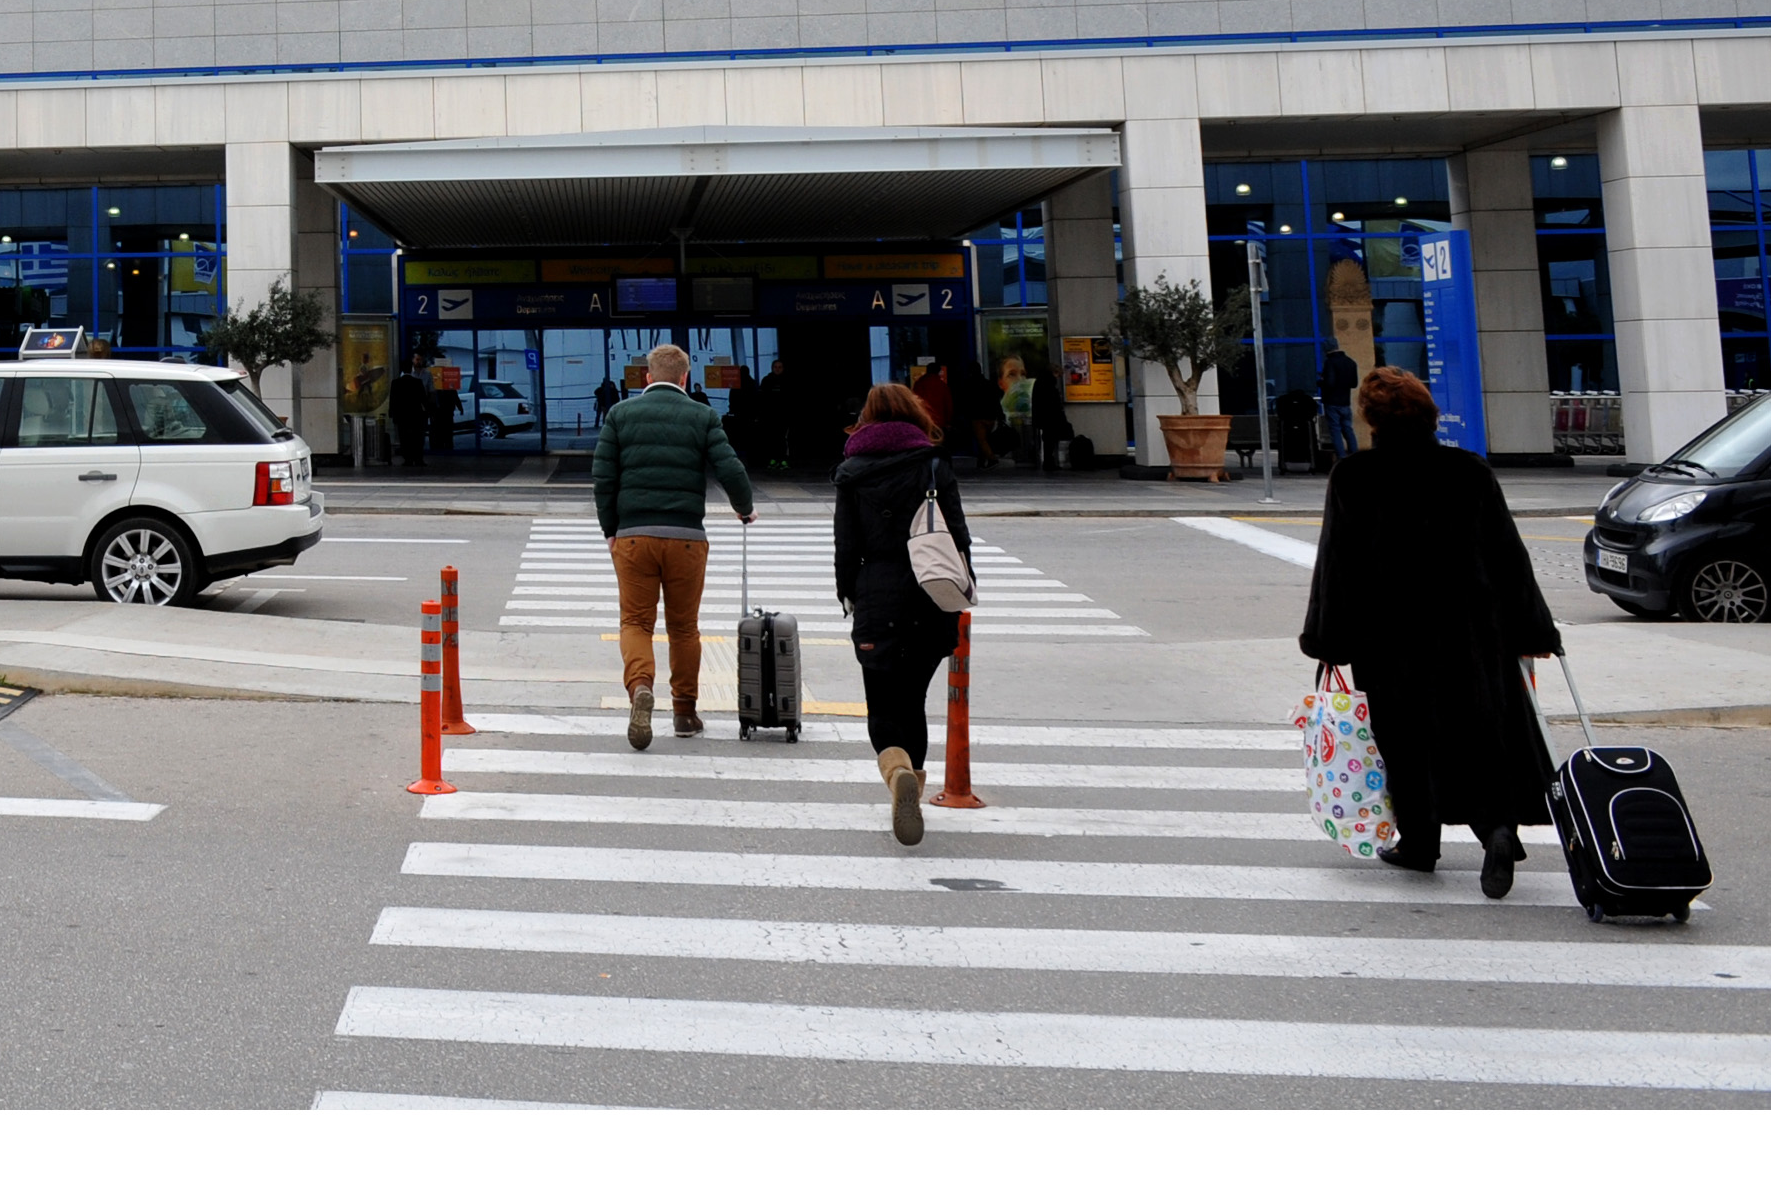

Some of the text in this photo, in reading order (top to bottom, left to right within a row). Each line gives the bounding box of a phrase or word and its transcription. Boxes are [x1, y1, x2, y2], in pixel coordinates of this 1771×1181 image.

[1440, 245, 1447, 274] 2
[417, 295, 428, 315] 2
[588, 293, 603, 313] A
[871, 290, 886, 310] A
[940, 288, 954, 310] 2
